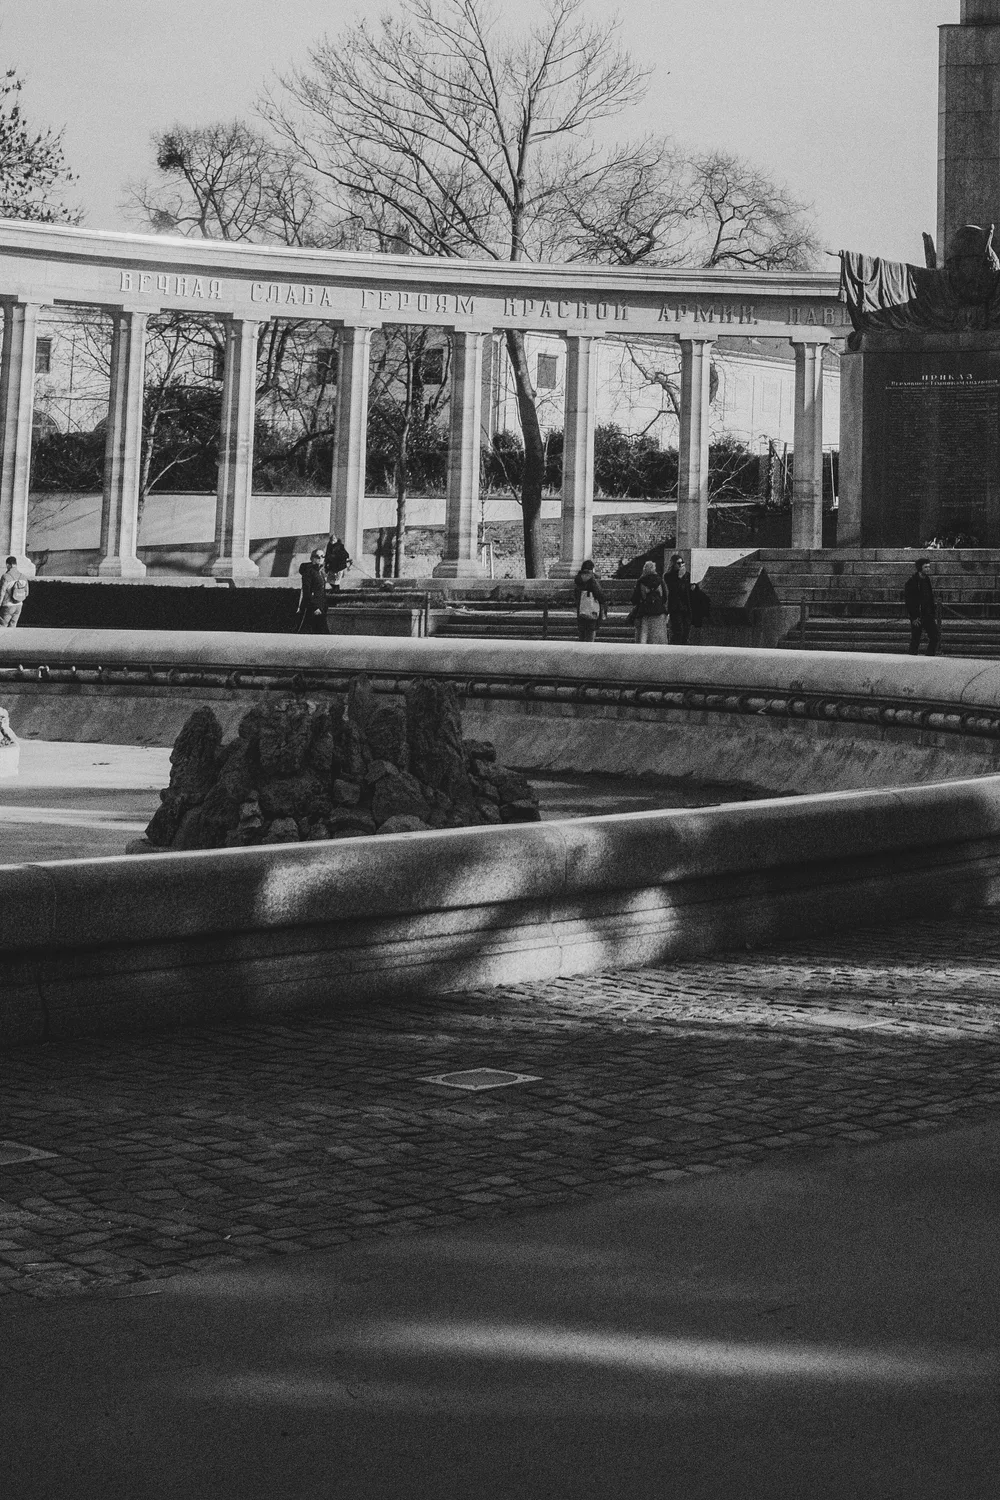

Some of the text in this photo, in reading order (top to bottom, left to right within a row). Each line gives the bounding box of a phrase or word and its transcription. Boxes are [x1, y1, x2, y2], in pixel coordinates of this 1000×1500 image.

[119, 271, 223, 299] ВЕЧНАЯ
[250, 282, 333, 308] СЛАВА
[361, 289, 475, 314] ГЕРОЯМ
[503, 297, 629, 321] КРАСНОЙ
